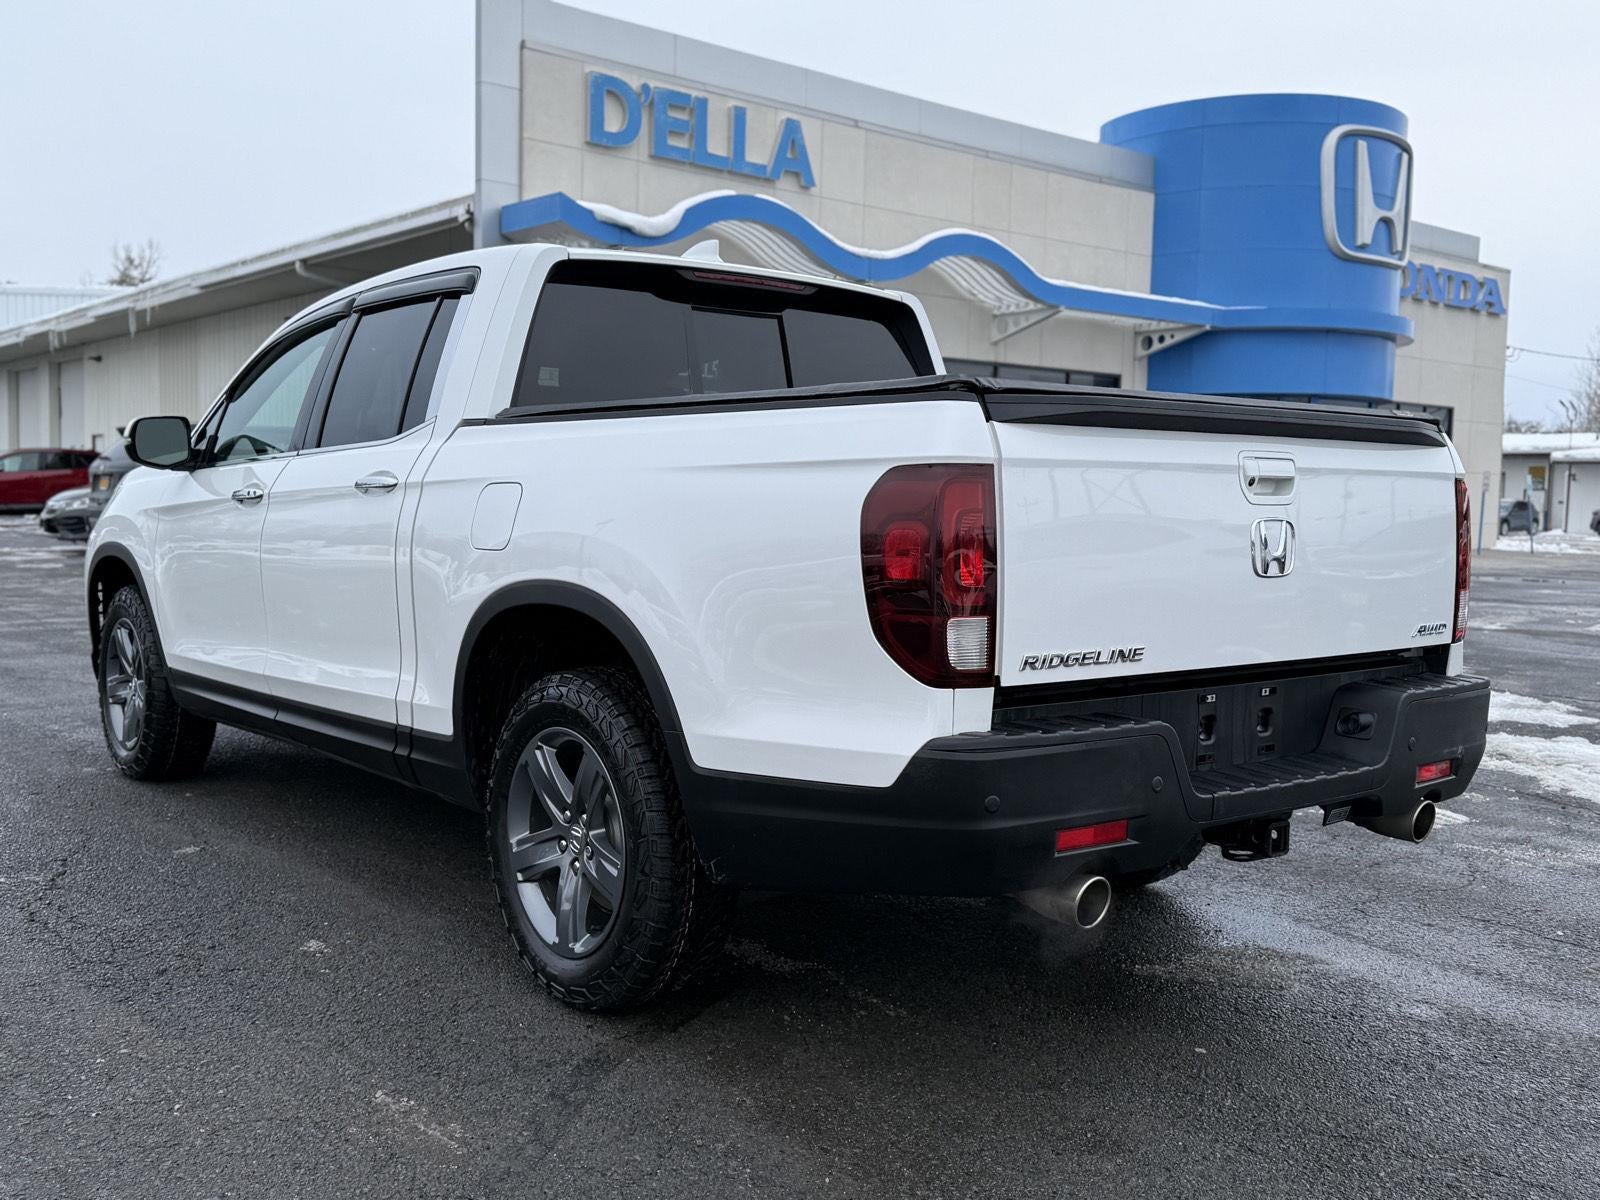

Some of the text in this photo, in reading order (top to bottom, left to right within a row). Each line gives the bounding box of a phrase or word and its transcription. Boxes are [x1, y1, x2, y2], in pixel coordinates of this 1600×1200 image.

[586, 70, 816, 189] D'ELLA
[1400, 260, 1506, 316] ONDA
[1019, 646, 1146, 672] RIDGELINE
